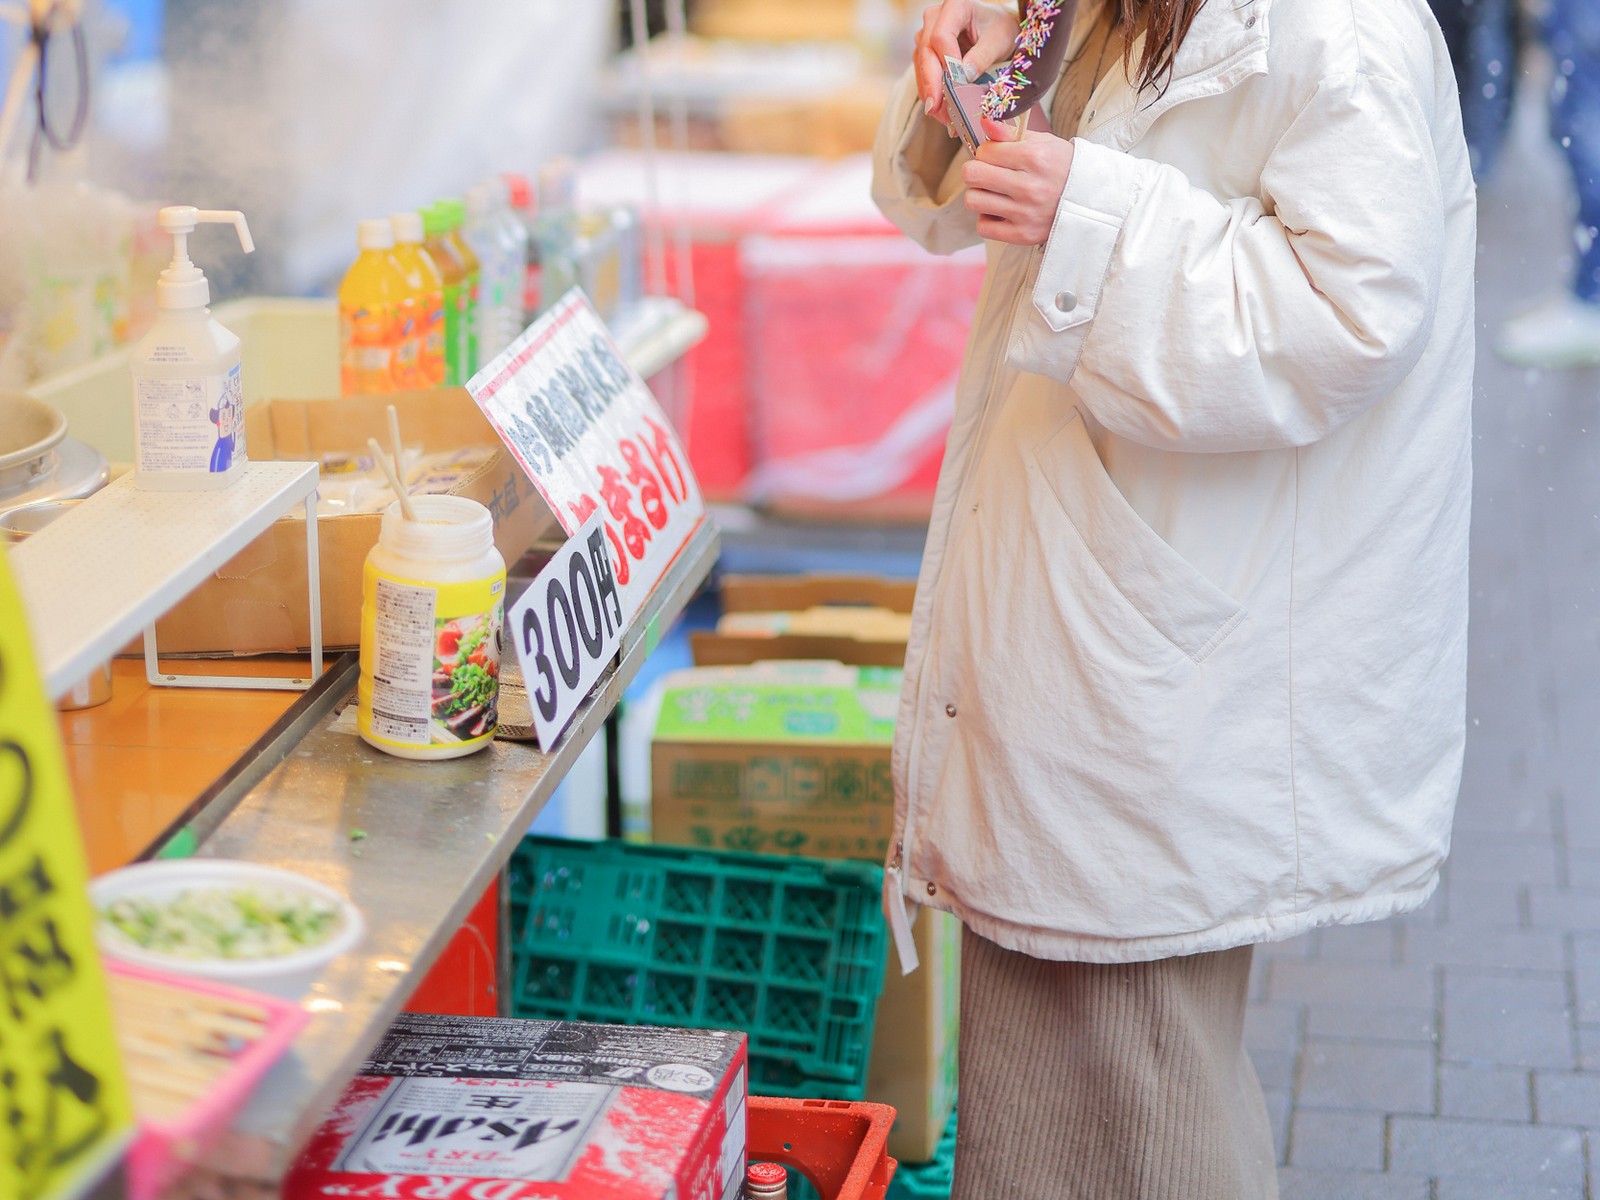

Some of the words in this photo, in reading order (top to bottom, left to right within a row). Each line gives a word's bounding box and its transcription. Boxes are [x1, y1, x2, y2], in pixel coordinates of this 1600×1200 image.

[523, 525, 622, 722] 300円
[465, 1095, 523, 1110] 生
[371, 1112, 581, 1152] Asahi
